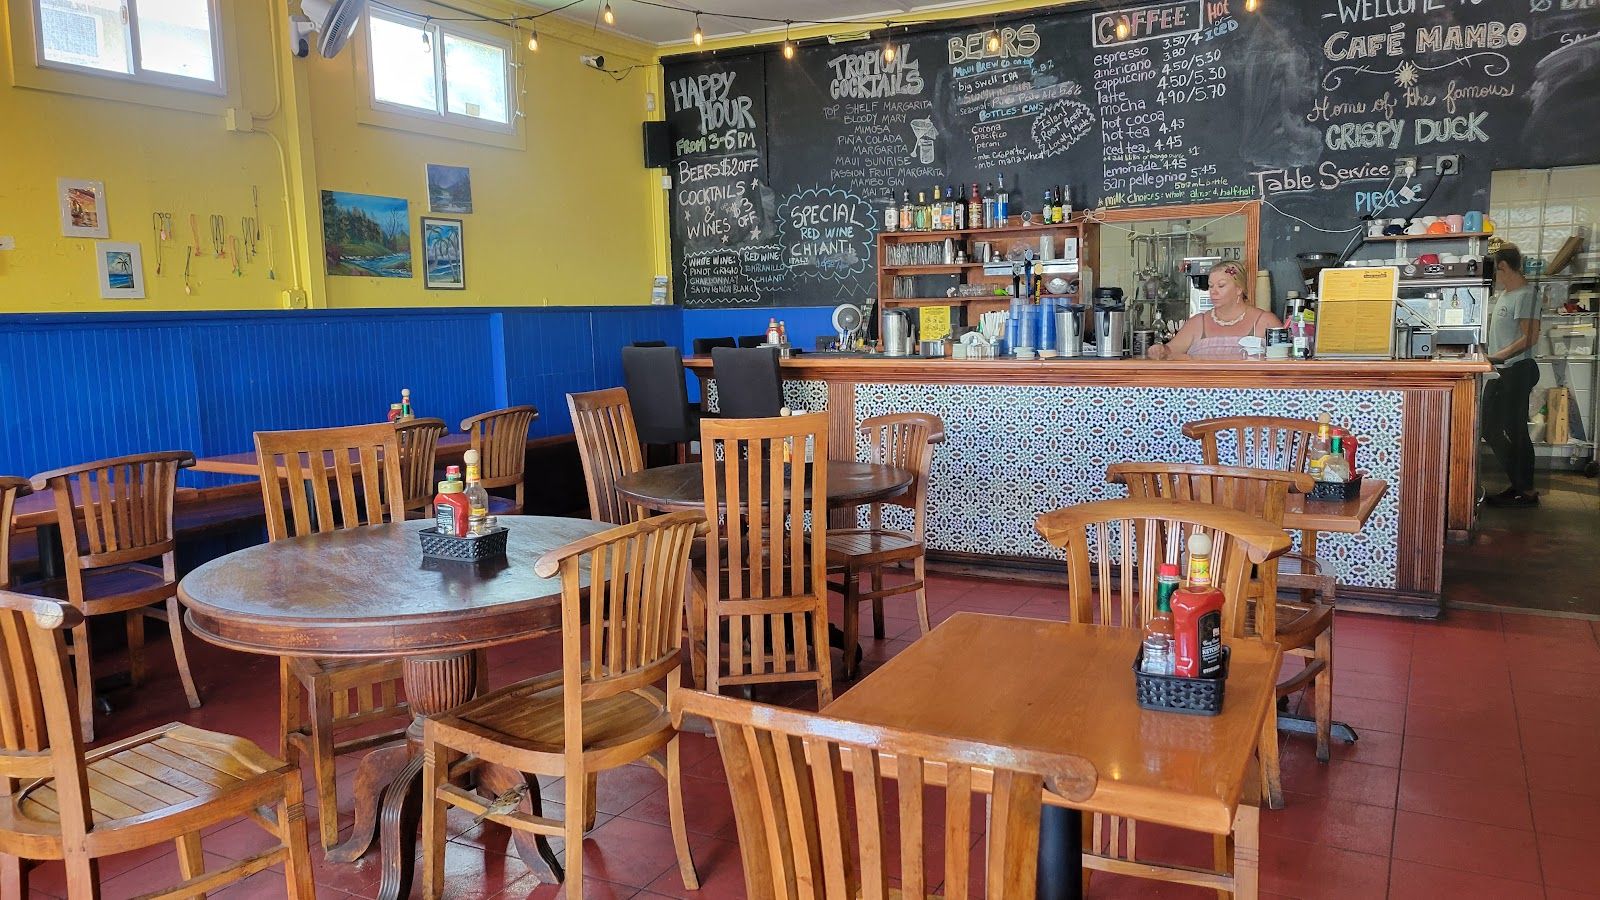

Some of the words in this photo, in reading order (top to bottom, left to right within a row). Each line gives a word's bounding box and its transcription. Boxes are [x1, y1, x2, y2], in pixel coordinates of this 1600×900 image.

[1207, 0, 1230, 24] Hot
[1205, 20, 1238, 41] ICED
[1323, 22, 1406, 61] CAFÉ
[1416, 22, 1527, 53] MAMBO
[827, 44, 919, 80] TROPICAL
[976, 60, 999, 73] BREW
[1094, 47, 1149, 68] espresso
[1094, 59, 1151, 79] americano
[1163, 48, 1185, 61] 3.80
[1094, 70, 1156, 92] cappuccino
[1162, 49, 1221, 75] 4.50/5.30
[830, 70, 925, 100] COCKTAILS
[958, 82, 973, 93] big
[975, 75, 998, 88] swell
[1002, 72, 1019, 83] IPA
[1098, 91, 1128, 105] latte
[1157, 66, 1226, 90] 4.50/5.30
[670, 72, 737, 113] HAPPY
[1042, 89, 1056, 99] Ale
[1101, 100, 1146, 116] mocha
[1156, 83, 1226, 106] 4.90/5.70
[1307, 96, 1366, 122] Home
[1371, 91, 1398, 120] of
[1403, 86, 1436, 108] the
[1443, 80, 1514, 114] famous
[699, 95, 757, 135] HOUR
[823, 104, 840, 118] TOP
[846, 102, 879, 114] SHELF
[883, 100, 933, 112] MARGARITA
[1021, 103, 1044, 113] CANS
[844, 113, 878, 125] BLOODY
[881, 114, 907, 125] MARY
[1041, 122, 1062, 141] ROOT
[1064, 108, 1083, 127] BEER
[1101, 116, 1120, 130] hot
[1126, 111, 1165, 126] cocoa
[854, 125, 891, 135] MIMOSA
[972, 124, 1001, 134] Corona
[974, 131, 1008, 143] pacifico
[1102, 129, 1123, 143] hot
[1128, 126, 1150, 138] tea
[1159, 118, 1185, 134] 4.45
[1325, 119, 1406, 150] CRISPY
[1415, 111, 1490, 145] DUCK
[676, 136, 707, 157] FROM
[737, 132, 757, 148] PM
[838, 135, 862, 145] PIÑA
[865, 135, 903, 144] COLADA
[977, 142, 1000, 152] peroni
[1103, 141, 1123, 156] iced
[1154, 136, 1183, 151] 4.45
[852, 145, 908, 155] MARGARITA
[835, 156, 861, 168] MAUI
[865, 156, 912, 167] SUNRISE
[1103, 161, 1162, 178] lemonade
[1163, 159, 1187, 170] 4.45
[678, 160, 720, 184] BEERS
[830, 169, 865, 180] PASSION
[869, 168, 894, 178] FRUIT
[897, 167, 945, 177] MARGARITA
[1104, 178, 1126, 191] san
[1130, 172, 1187, 193] pellegrino
[1191, 165, 1217, 178] 5.45
[1250, 168, 1314, 197] Table
[1318, 161, 1391, 190] Service
[851, 178, 884, 188] MAMBO
[887, 178, 905, 186] GIN
[861, 187, 877, 197] MAI
[679, 180, 746, 206] COCKTAILS
[1105, 191, 1126, 206] milk
[704, 205, 716, 223] &
[737, 210, 758, 227] OFF
[790, 203, 865, 228] SPECIAL
[687, 218, 731, 240] WINES
[800, 227, 820, 240] RED
[825, 226, 854, 239] WINE
[744, 252, 759, 263] RED
[791, 240, 852, 256] CHIANTI
[688, 256, 711, 267] WHITE
[713, 254, 737, 266] WINE:
[689, 268, 711, 276] PINOT
[713, 267, 739, 275] GRIGIO
